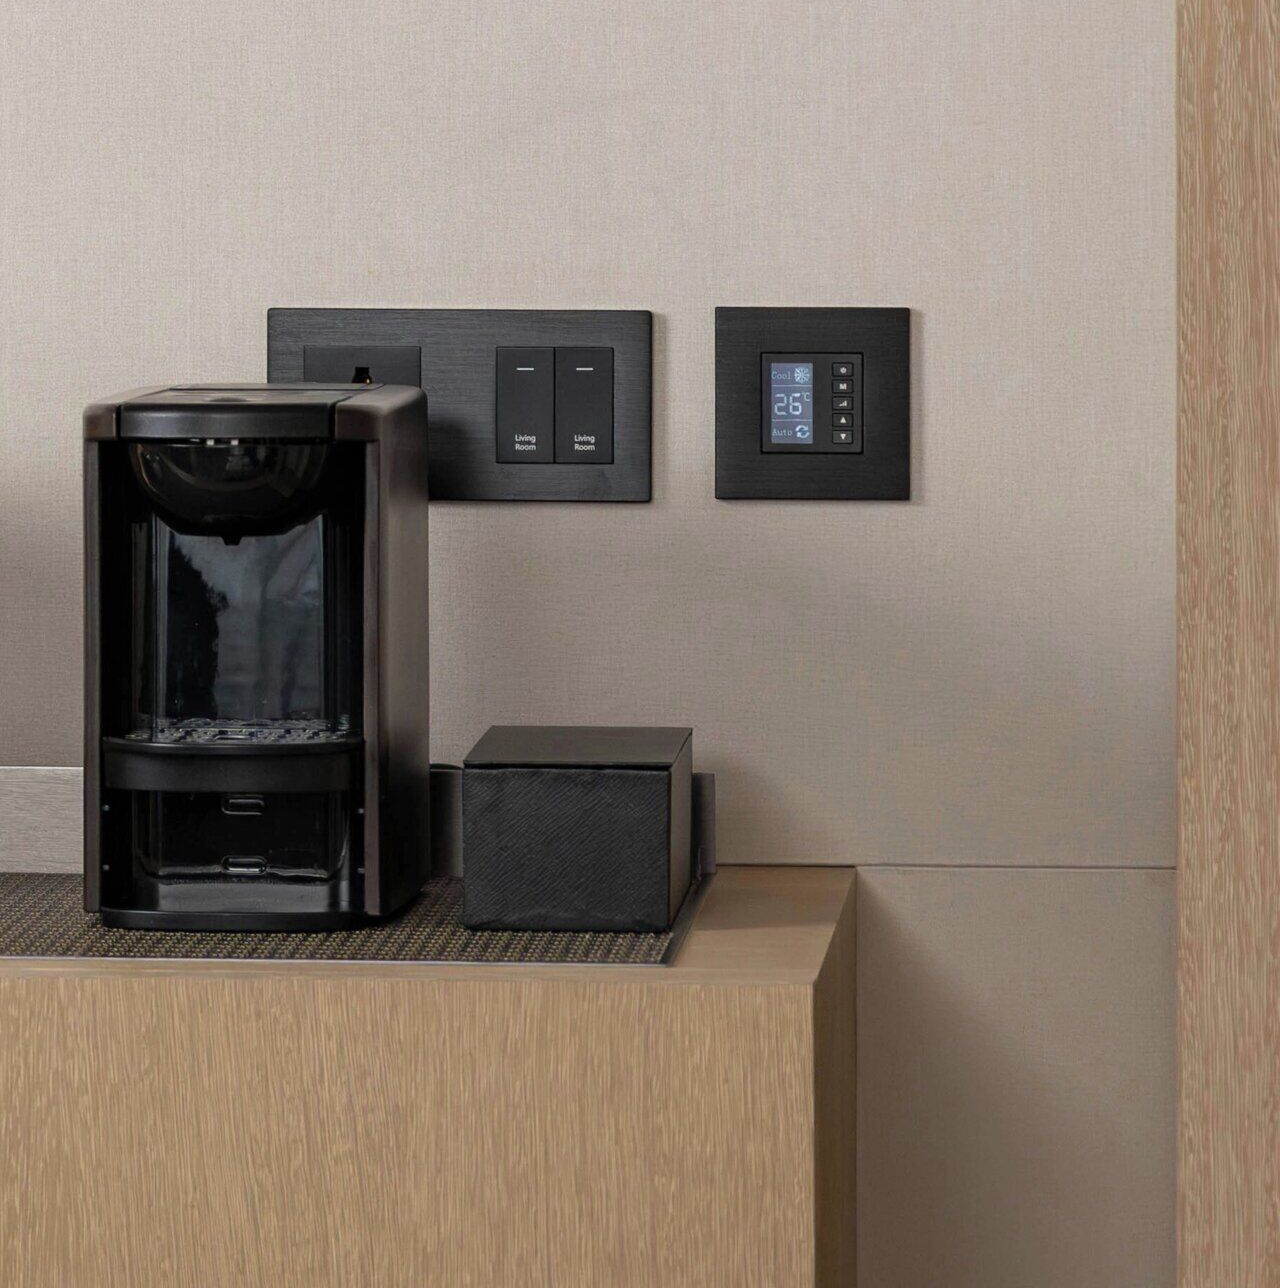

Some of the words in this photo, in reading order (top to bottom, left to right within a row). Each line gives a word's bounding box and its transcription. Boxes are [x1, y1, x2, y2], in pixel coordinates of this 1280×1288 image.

[772, 371, 791, 379] Cool
[772, 428, 792, 436] Auto
[515, 434, 536, 443] Living
[574, 435, 595, 443] Living
